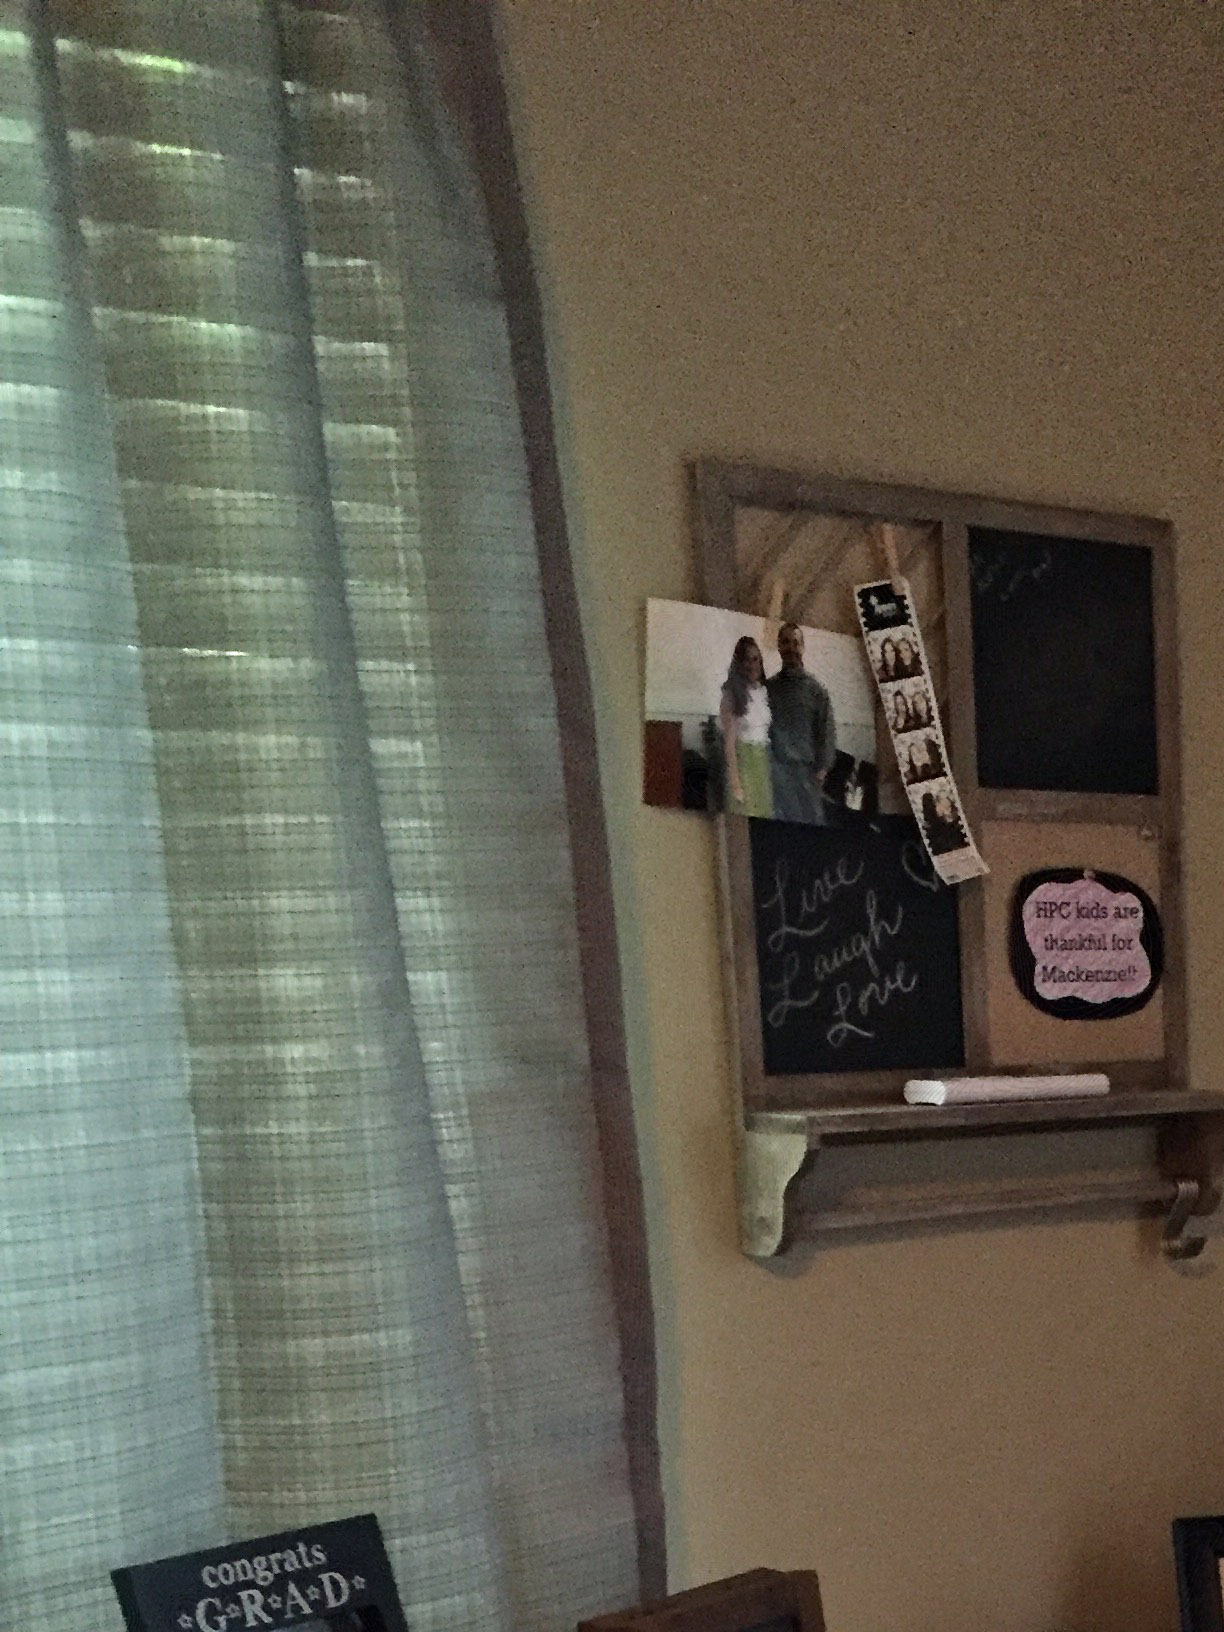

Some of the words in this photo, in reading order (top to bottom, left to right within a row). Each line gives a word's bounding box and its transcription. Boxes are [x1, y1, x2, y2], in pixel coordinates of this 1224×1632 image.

[1035, 901, 1072, 919] HPC
[1076, 901, 1108, 919] kids
[1113, 905, 1140, 919] are
[1043, 933, 1108, 951] thankful
[1111, 933, 1134, 951] for
[201, 1541, 328, 1589] congrats
